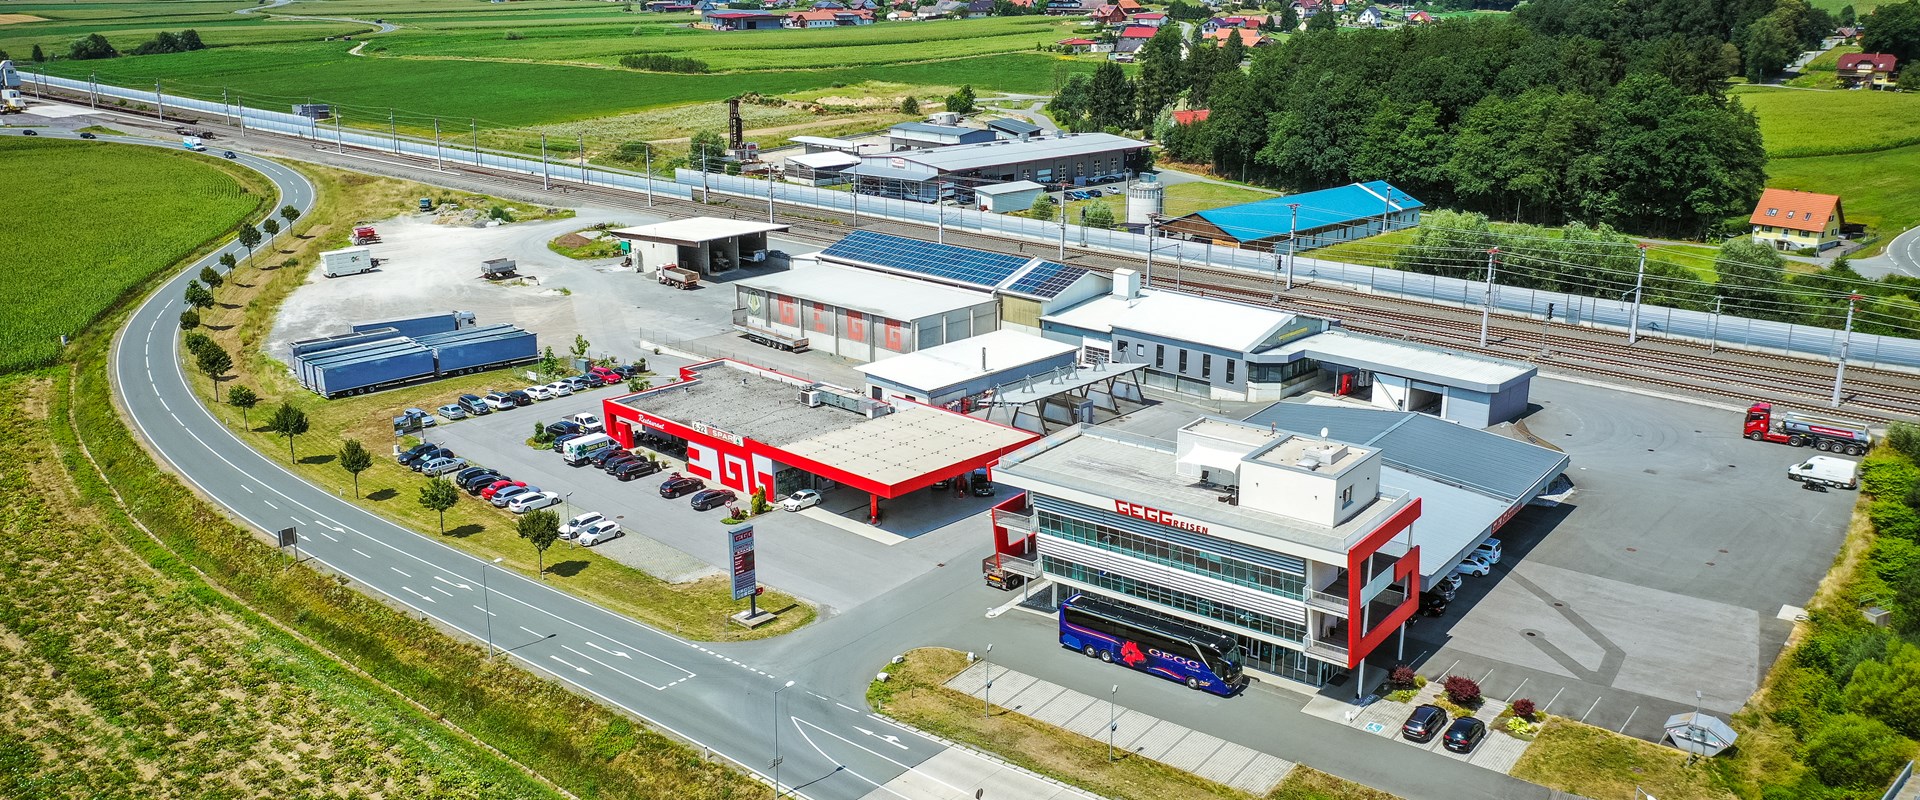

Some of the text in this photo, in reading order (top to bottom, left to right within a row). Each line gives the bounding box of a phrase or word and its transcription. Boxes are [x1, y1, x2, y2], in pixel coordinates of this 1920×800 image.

[712, 429, 734, 441] SPAR
[1115, 500, 1208, 534] GEGG REISEN
[1148, 648, 1200, 669] GEGG
